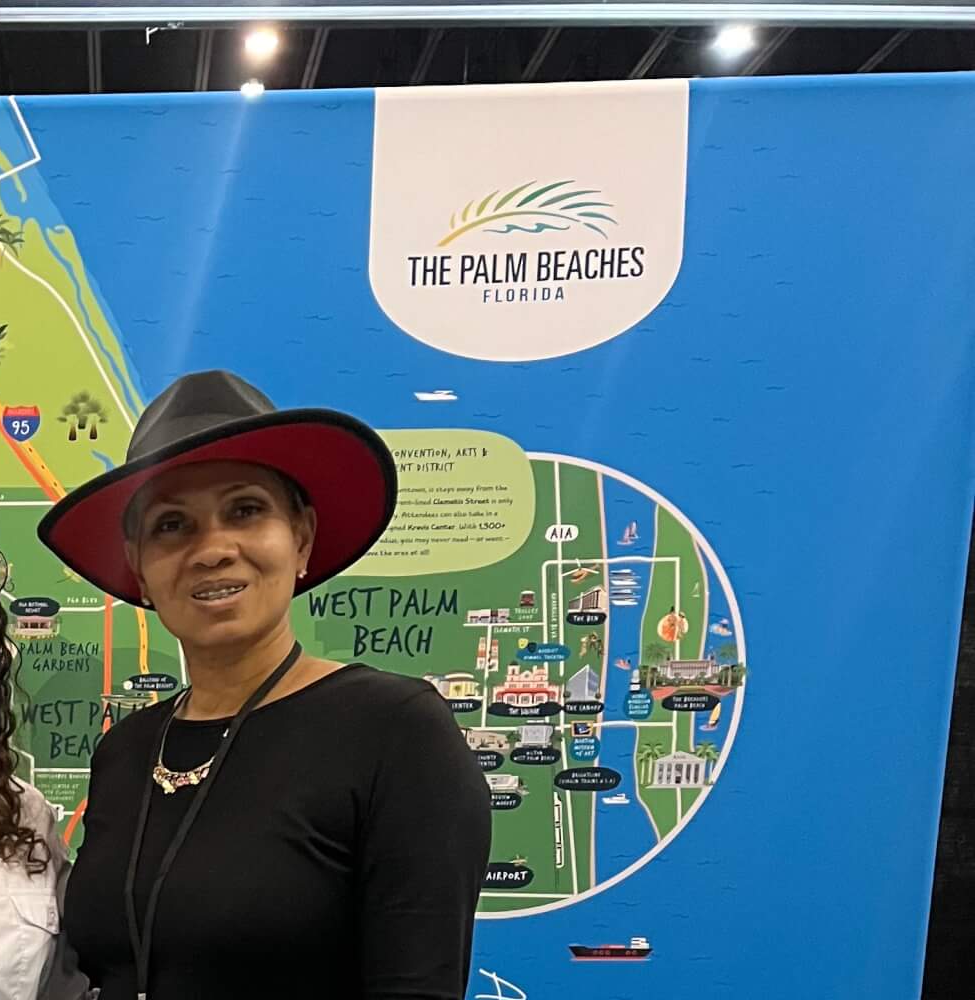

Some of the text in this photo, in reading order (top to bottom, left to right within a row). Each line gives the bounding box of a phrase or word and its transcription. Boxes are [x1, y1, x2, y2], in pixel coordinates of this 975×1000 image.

[408, 247, 645, 286] THE PALM BEACHES
[483, 288, 565, 304] FLORIDA
[12, 420, 31, 436] 95
[456, 448, 477, 458] ARTS
[417, 462, 455, 472] DISTRICT
[465, 497, 489, 506] Street
[309, 587, 459, 620] WEST PALM
[354, 624, 433, 658] BEACH
[19, 641, 99, 658] PALM BEACH
[32, 657, 91, 672] GARDENS
[21, 700, 83, 728] WEST
[50, 731, 103, 760] BEAC
[486, 871, 529, 882] AIRPORT
